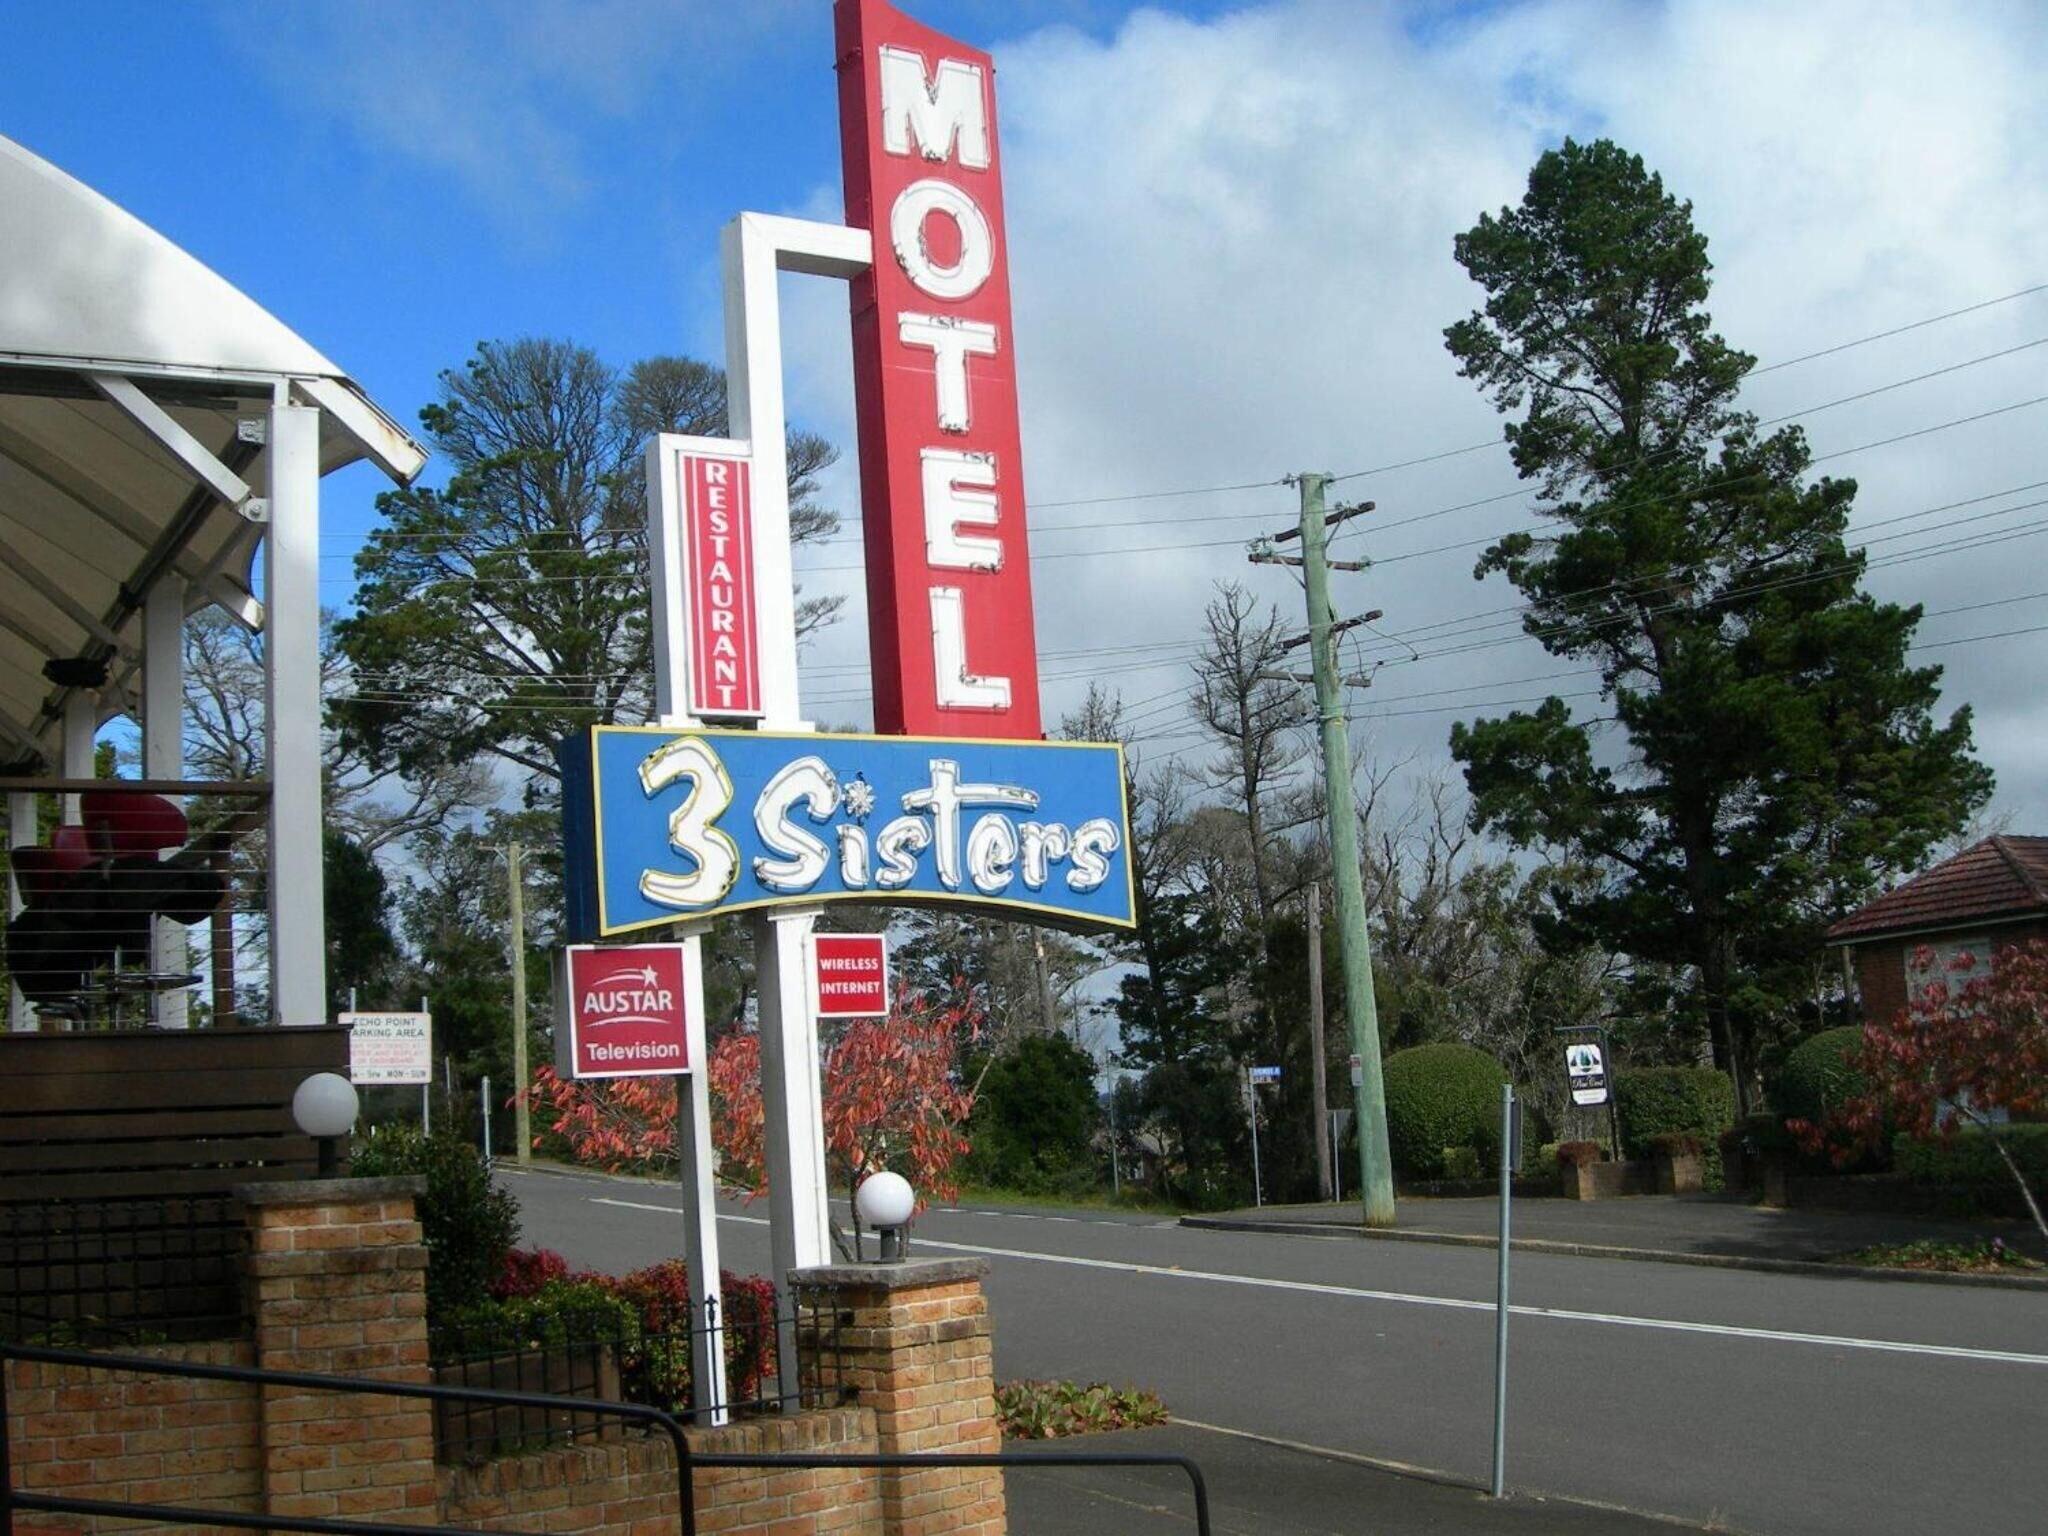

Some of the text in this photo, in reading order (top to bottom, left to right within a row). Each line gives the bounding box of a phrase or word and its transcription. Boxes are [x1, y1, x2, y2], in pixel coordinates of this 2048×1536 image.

[879, 43, 1011, 711] MOTEL
[704, 461, 738, 708] RESTAURANT
[637, 735, 1121, 910] 3 Sisters
[819, 957, 879, 970] WIRELESS
[820, 981, 880, 994] INTERNET
[583, 989, 674, 1014] AUSTAR
[353, 1017, 416, 1026] ECHO POINT
[352, 1028, 424, 1037] ARKING AREA
[585, 1041, 680, 1061] Television
